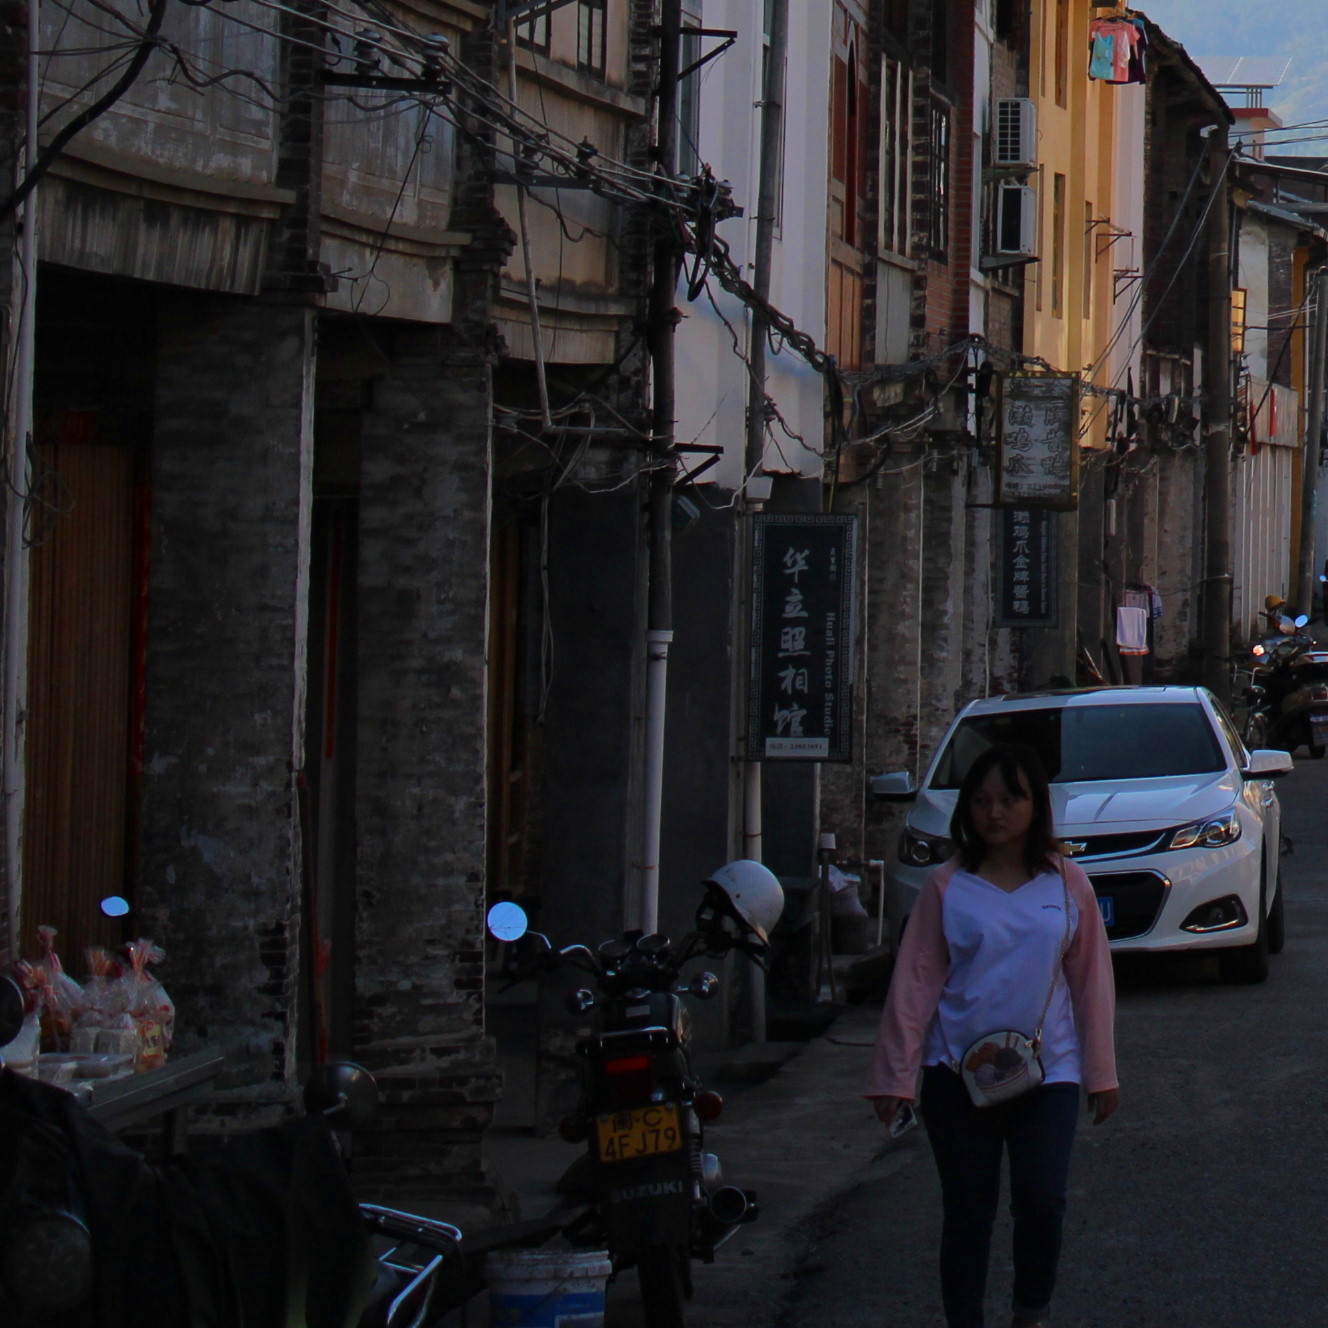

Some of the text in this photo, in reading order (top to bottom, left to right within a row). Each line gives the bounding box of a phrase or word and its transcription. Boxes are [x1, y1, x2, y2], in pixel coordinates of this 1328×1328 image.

[773, 546, 811, 737] 华立照相馆
[823, 611, 836, 735] Huali Photo Studio
[605, 1126, 677, 1159] 4FJ79
[610, 1180, 684, 1204] SUZUKI
